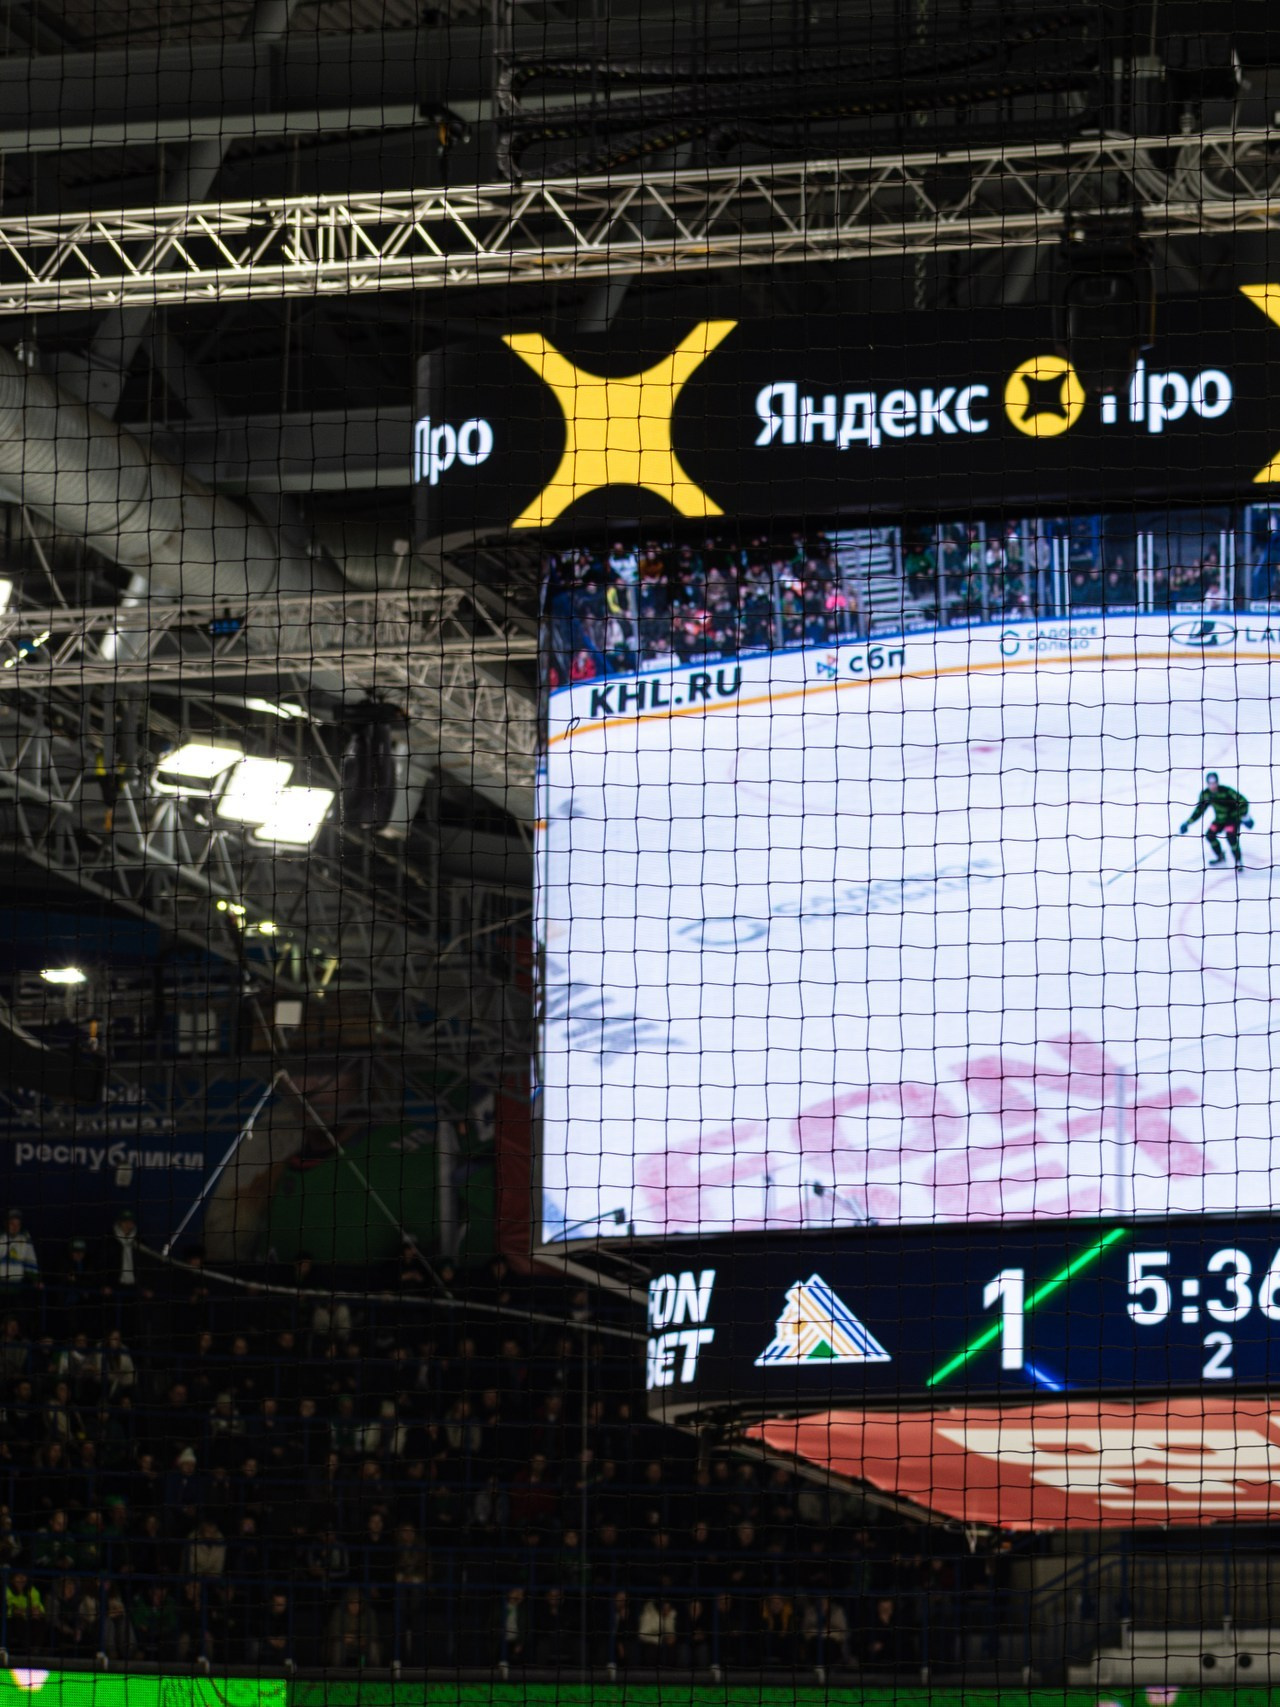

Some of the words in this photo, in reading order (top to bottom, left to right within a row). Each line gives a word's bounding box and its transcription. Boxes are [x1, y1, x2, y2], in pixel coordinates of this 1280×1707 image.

[754, 382, 989, 450] Яндекс
[414, 415, 494, 486] Про
[848, 647, 906, 673] сбп
[590, 666, 743, 718] KHL.RU
[983, 1268, 1025, 1370] 1
[1202, 1332, 1234, 1379] 2
